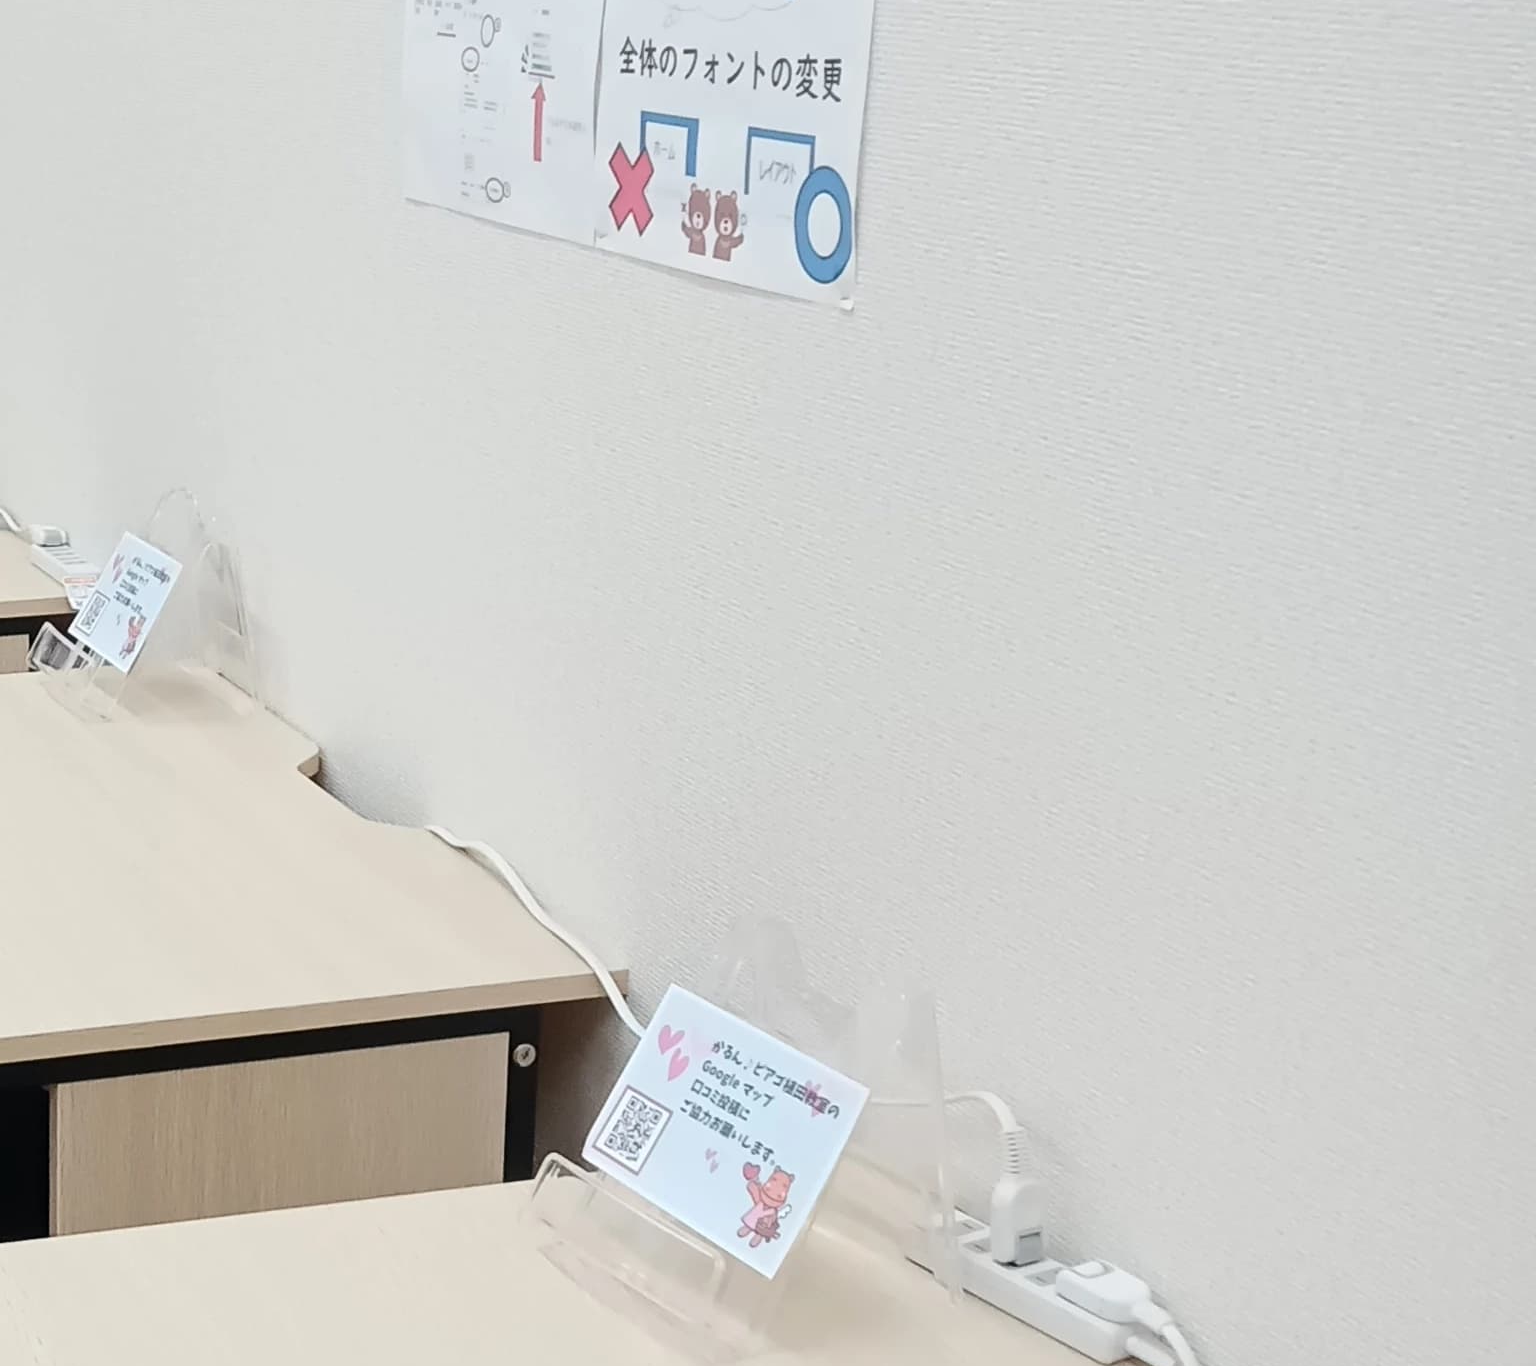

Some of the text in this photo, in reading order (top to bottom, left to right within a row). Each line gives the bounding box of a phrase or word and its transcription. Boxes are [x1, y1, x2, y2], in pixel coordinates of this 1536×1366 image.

[618, 35, 844, 103] 全体のフォントの変更
[701, 1059, 776, 1108] Google マップ
